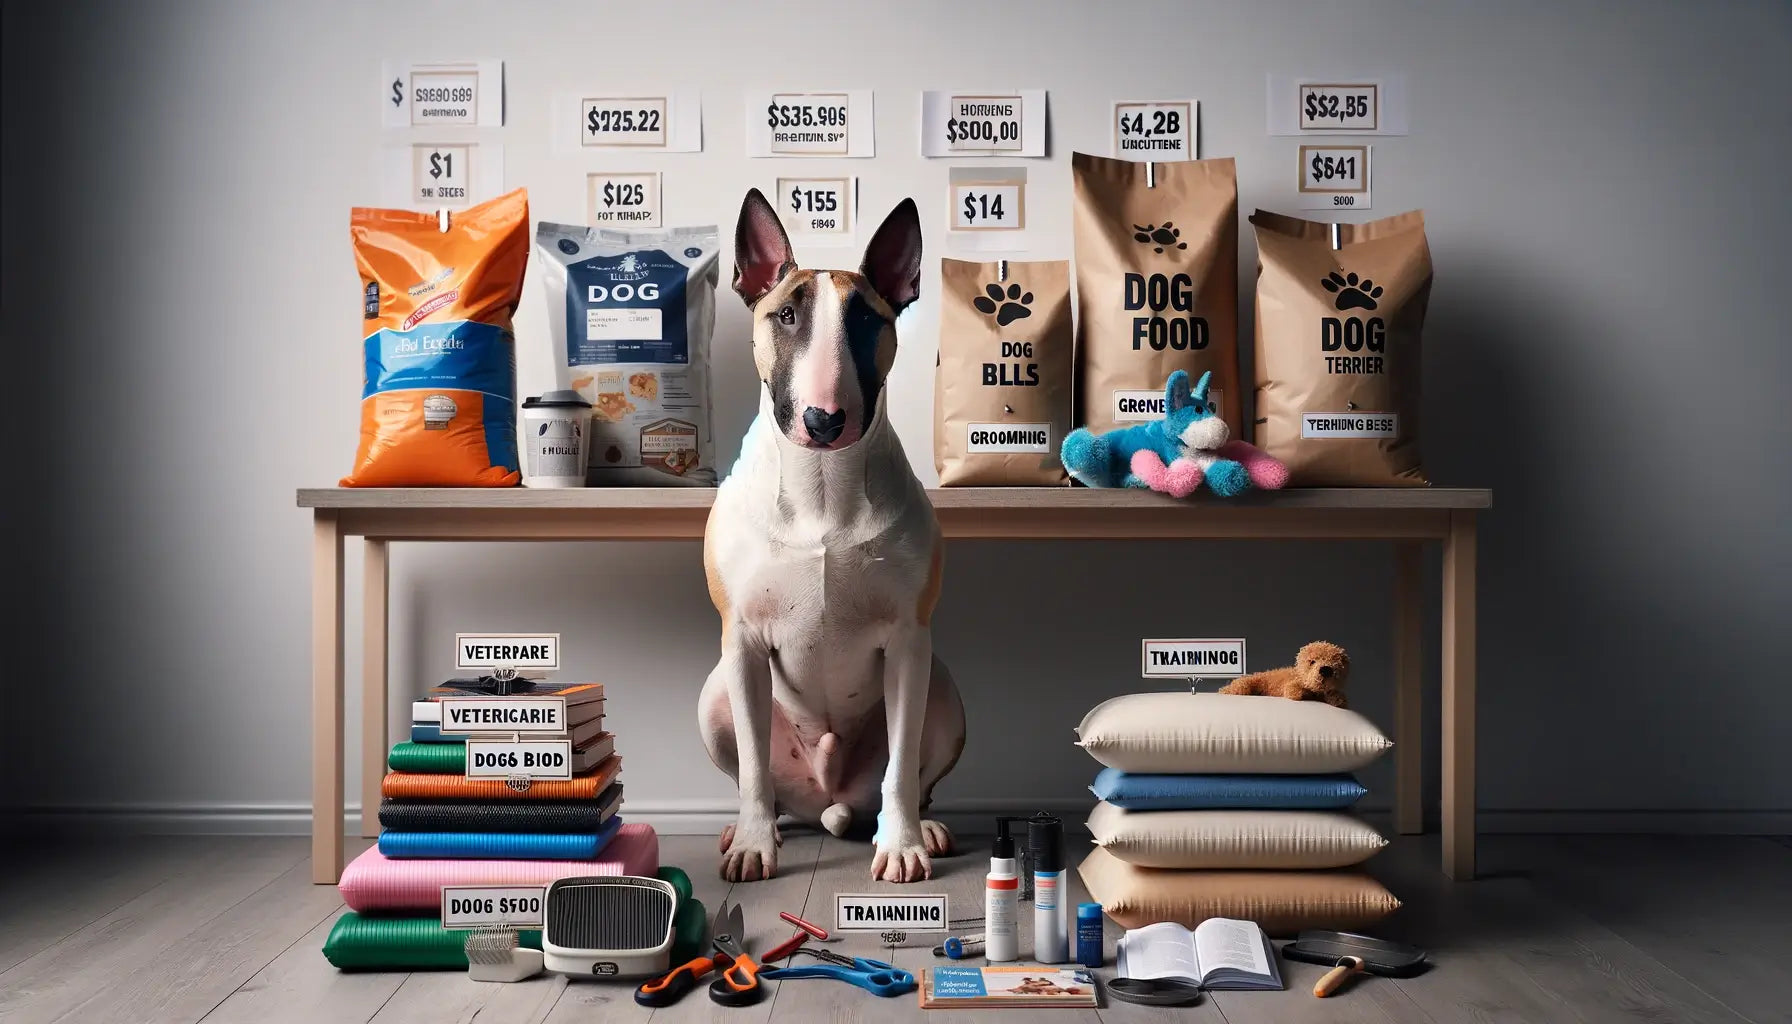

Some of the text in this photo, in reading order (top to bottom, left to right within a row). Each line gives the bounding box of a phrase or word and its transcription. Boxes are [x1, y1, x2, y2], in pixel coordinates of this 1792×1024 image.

[791, 186, 836, 213] $155
[963, 192, 1004, 224] $14
[588, 282, 660, 303] DOG
[1124, 272, 1193, 312] DOG
[1132, 316, 1210, 351] FOOD
[1321, 316, 1385, 353] DOG
[1001, 341, 1033, 359] DOG
[982, 363, 1039, 386] BLLS
[1325, 356, 1384, 374] TERRIER
[465, 645, 549, 660] VETERPARE
[523, 751, 563, 768] BIOD
